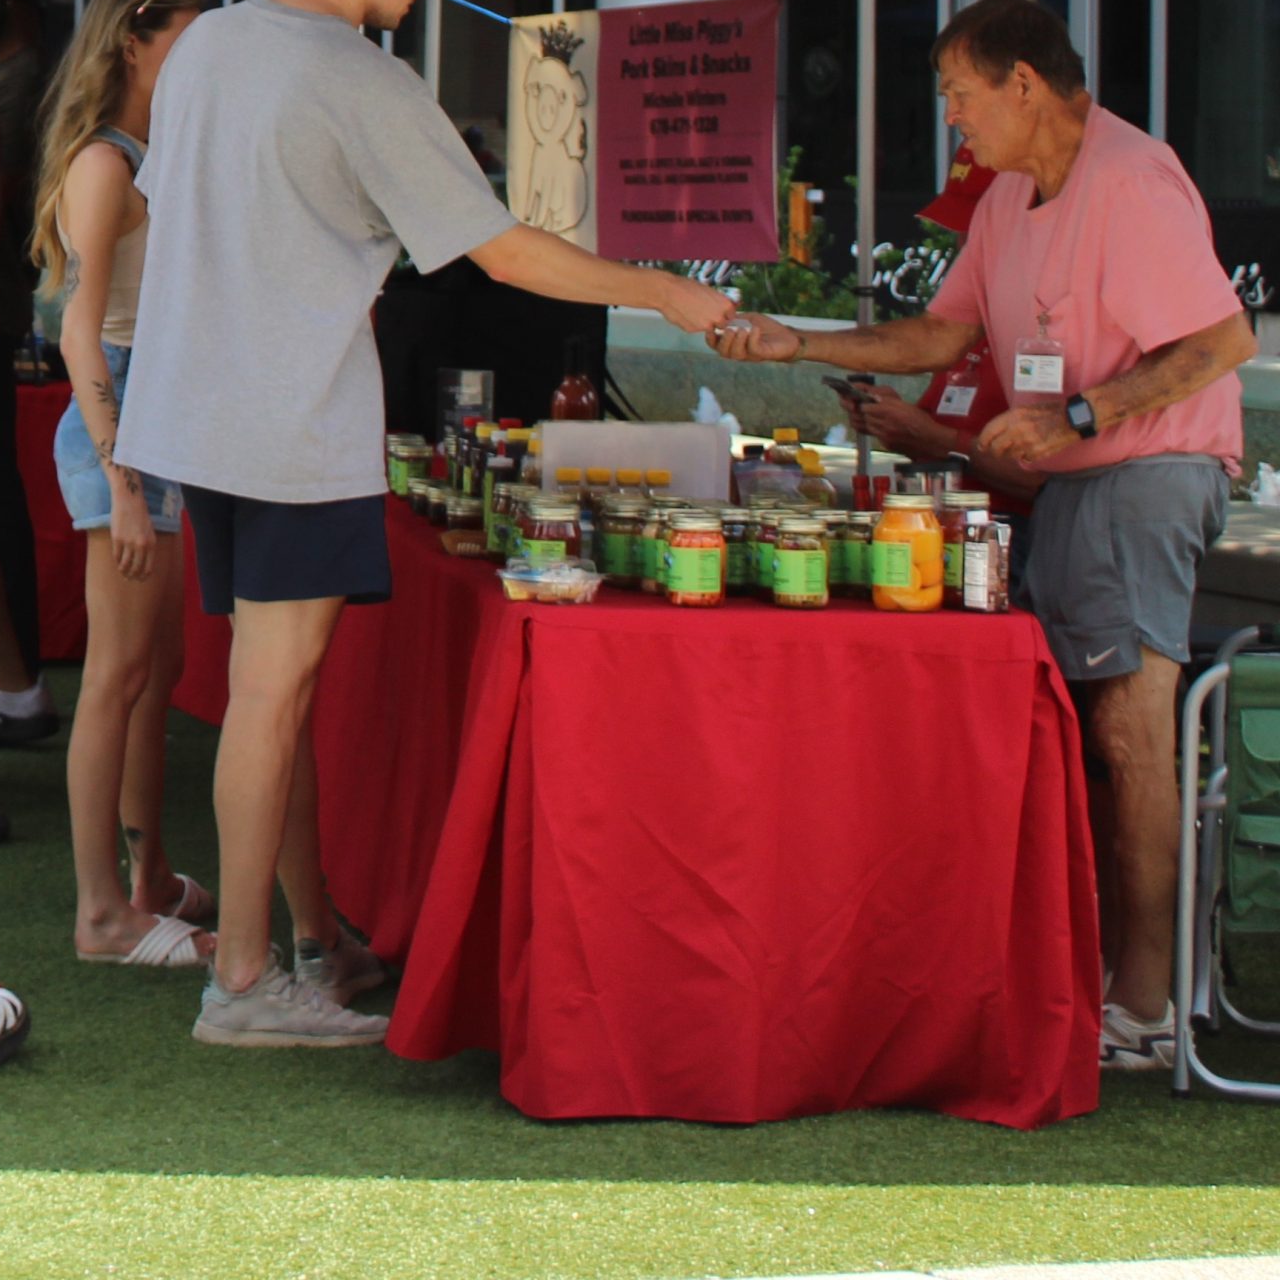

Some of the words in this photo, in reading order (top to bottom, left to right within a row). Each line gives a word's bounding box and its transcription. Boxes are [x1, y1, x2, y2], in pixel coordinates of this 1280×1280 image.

[628, 24, 661, 46] Little
[664, 22, 694, 43] Miss
[621, 58, 649, 80] Pork
[702, 52, 751, 75] Snacks
